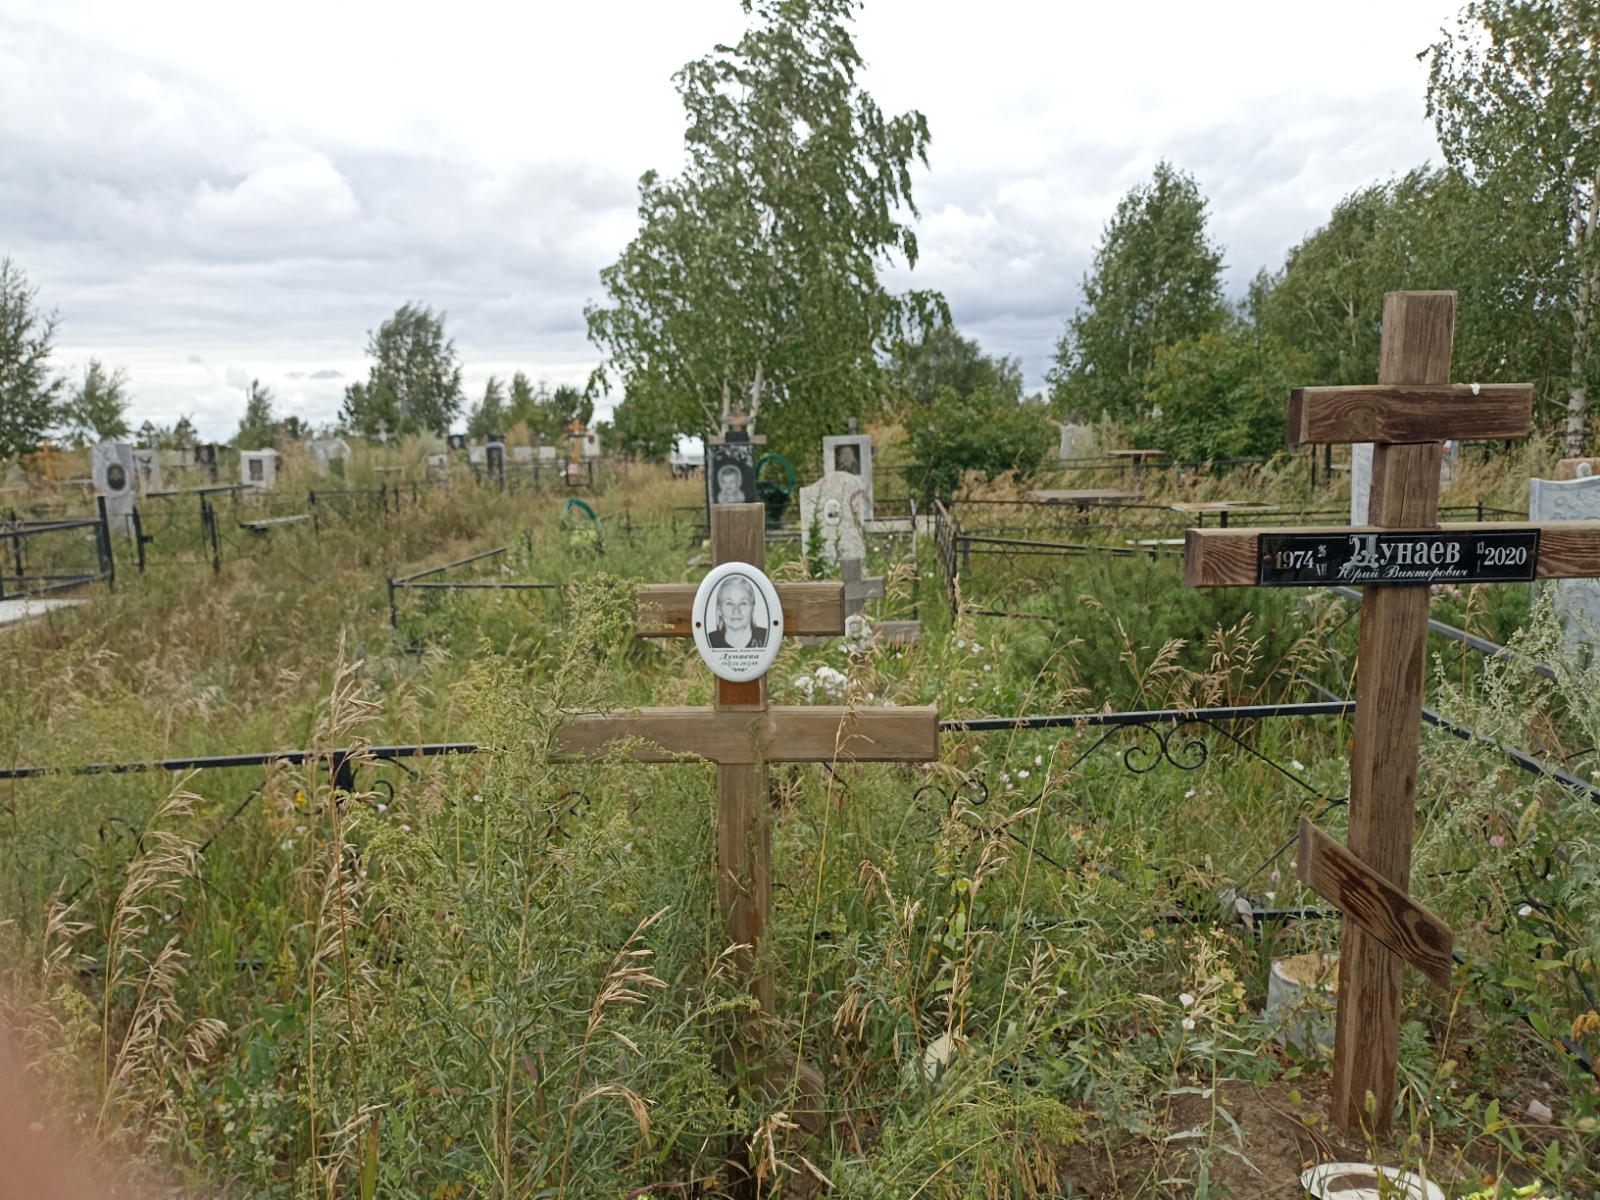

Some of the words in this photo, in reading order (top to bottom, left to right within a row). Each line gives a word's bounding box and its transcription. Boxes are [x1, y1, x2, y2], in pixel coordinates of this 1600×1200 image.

[1274, 550, 1314, 569] 1974
[1342, 534, 1461, 568] Дунаев
[1483, 546, 1527, 565] 2020
[1334, 565, 1379, 583] Юрий
[1383, 564, 1468, 582] Викторович
